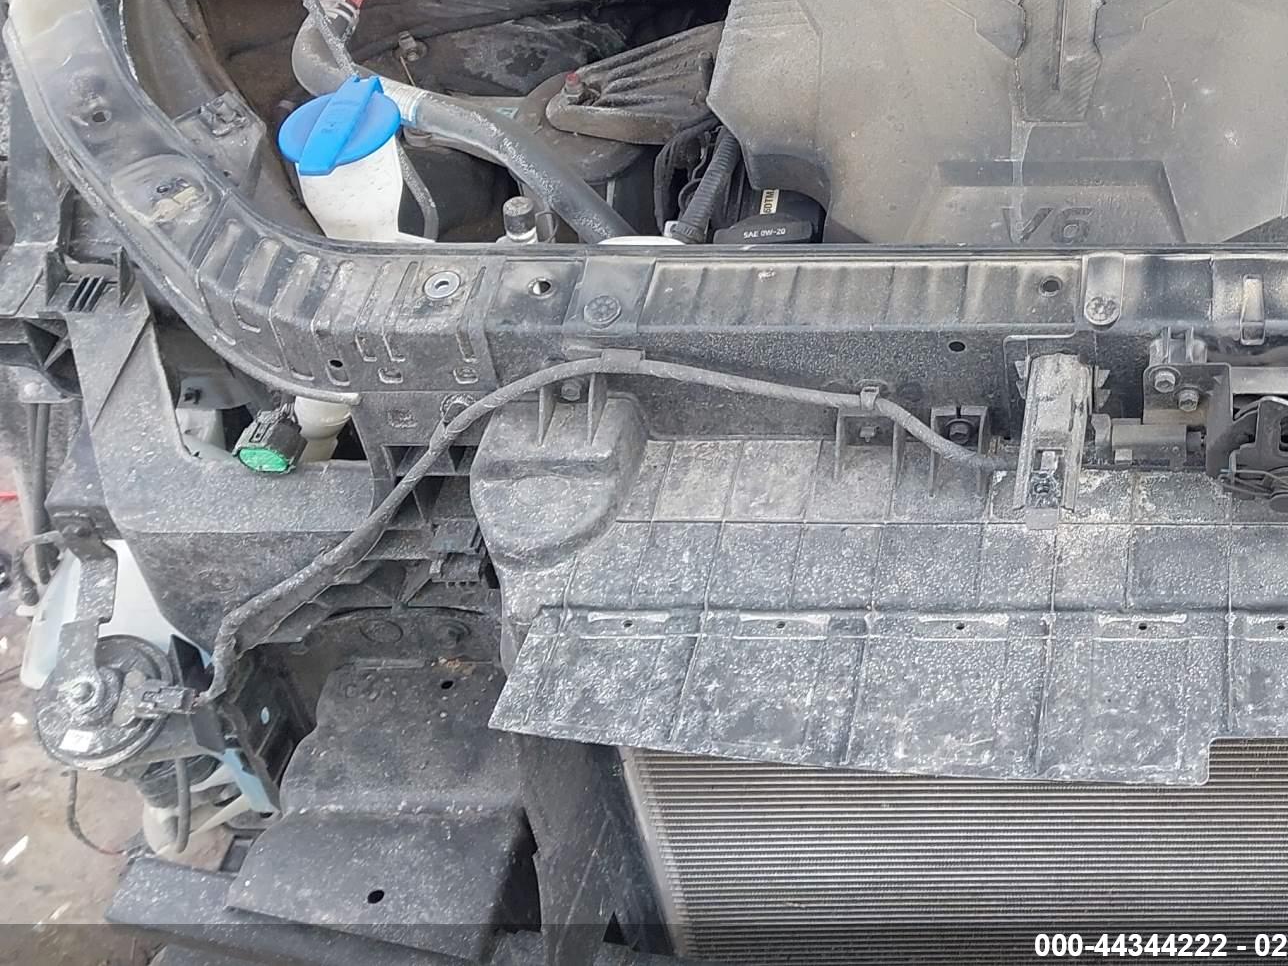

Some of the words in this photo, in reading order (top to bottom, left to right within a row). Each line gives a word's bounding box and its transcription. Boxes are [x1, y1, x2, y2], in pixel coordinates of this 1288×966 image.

[743, 231, 759, 239] SAE
[760, 228, 786, 237] 0W-20
[1001, 206, 1095, 244] V6
